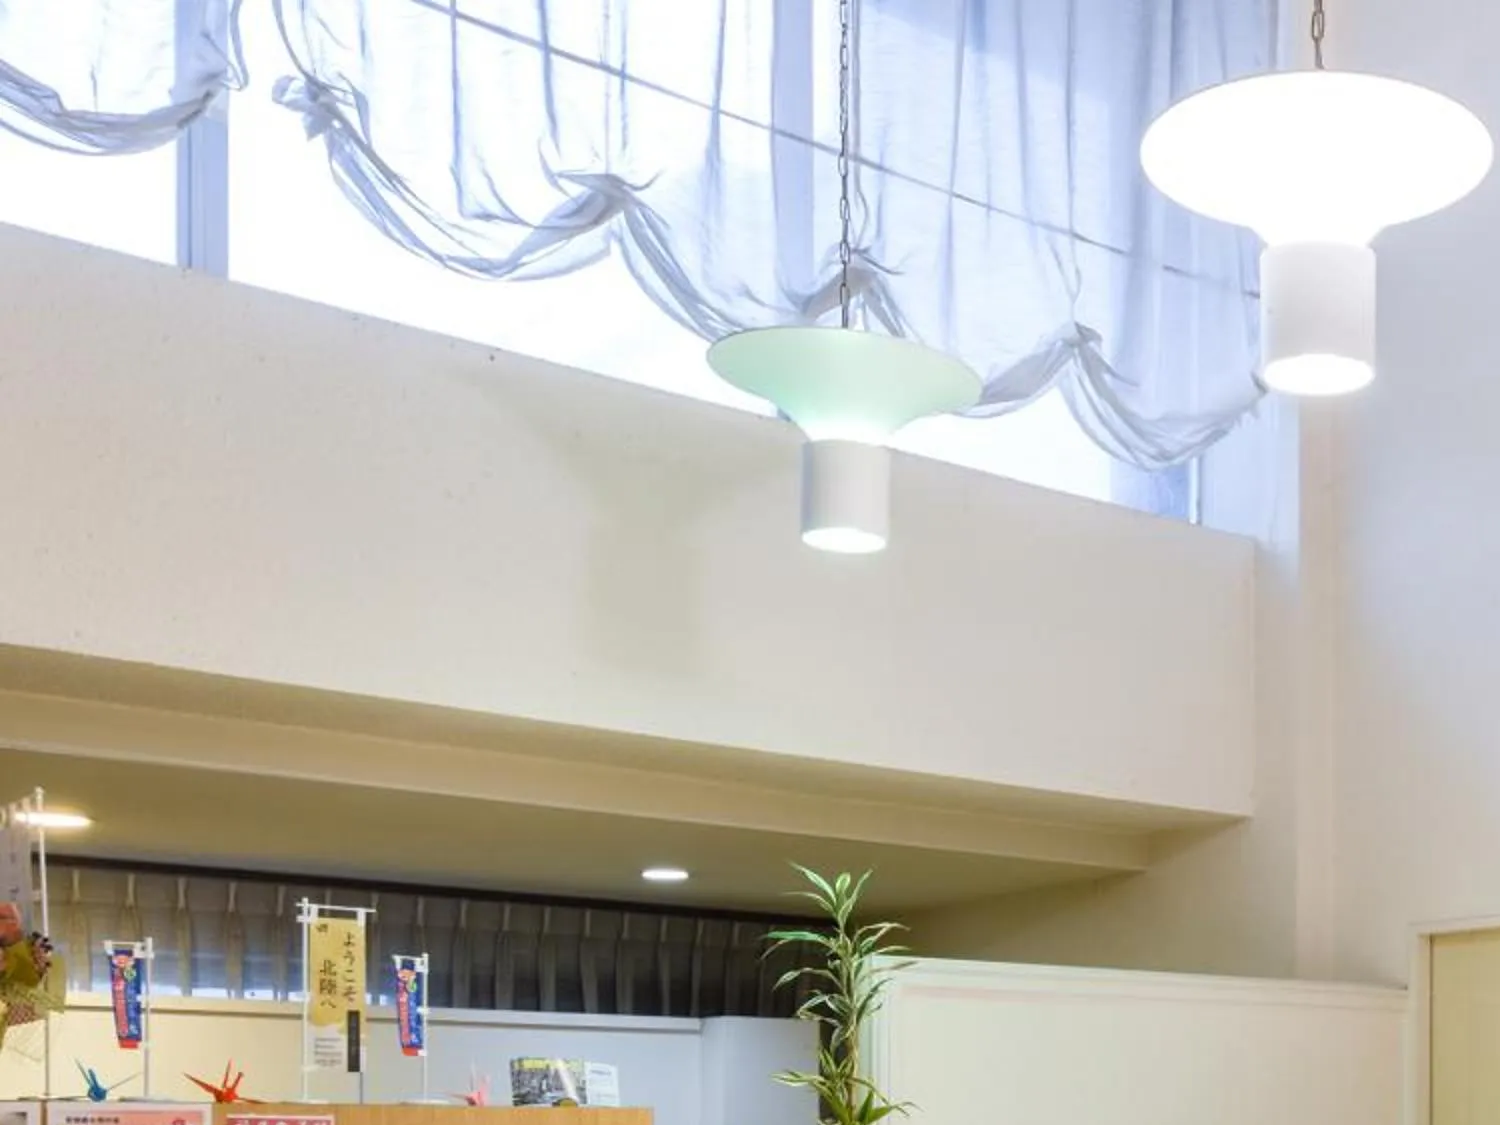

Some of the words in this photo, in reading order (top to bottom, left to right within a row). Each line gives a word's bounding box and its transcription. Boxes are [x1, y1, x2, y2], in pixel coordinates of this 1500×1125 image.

[319, 959, 337, 1009] 北陸へ
[343, 931, 357, 1003] ようこそ
